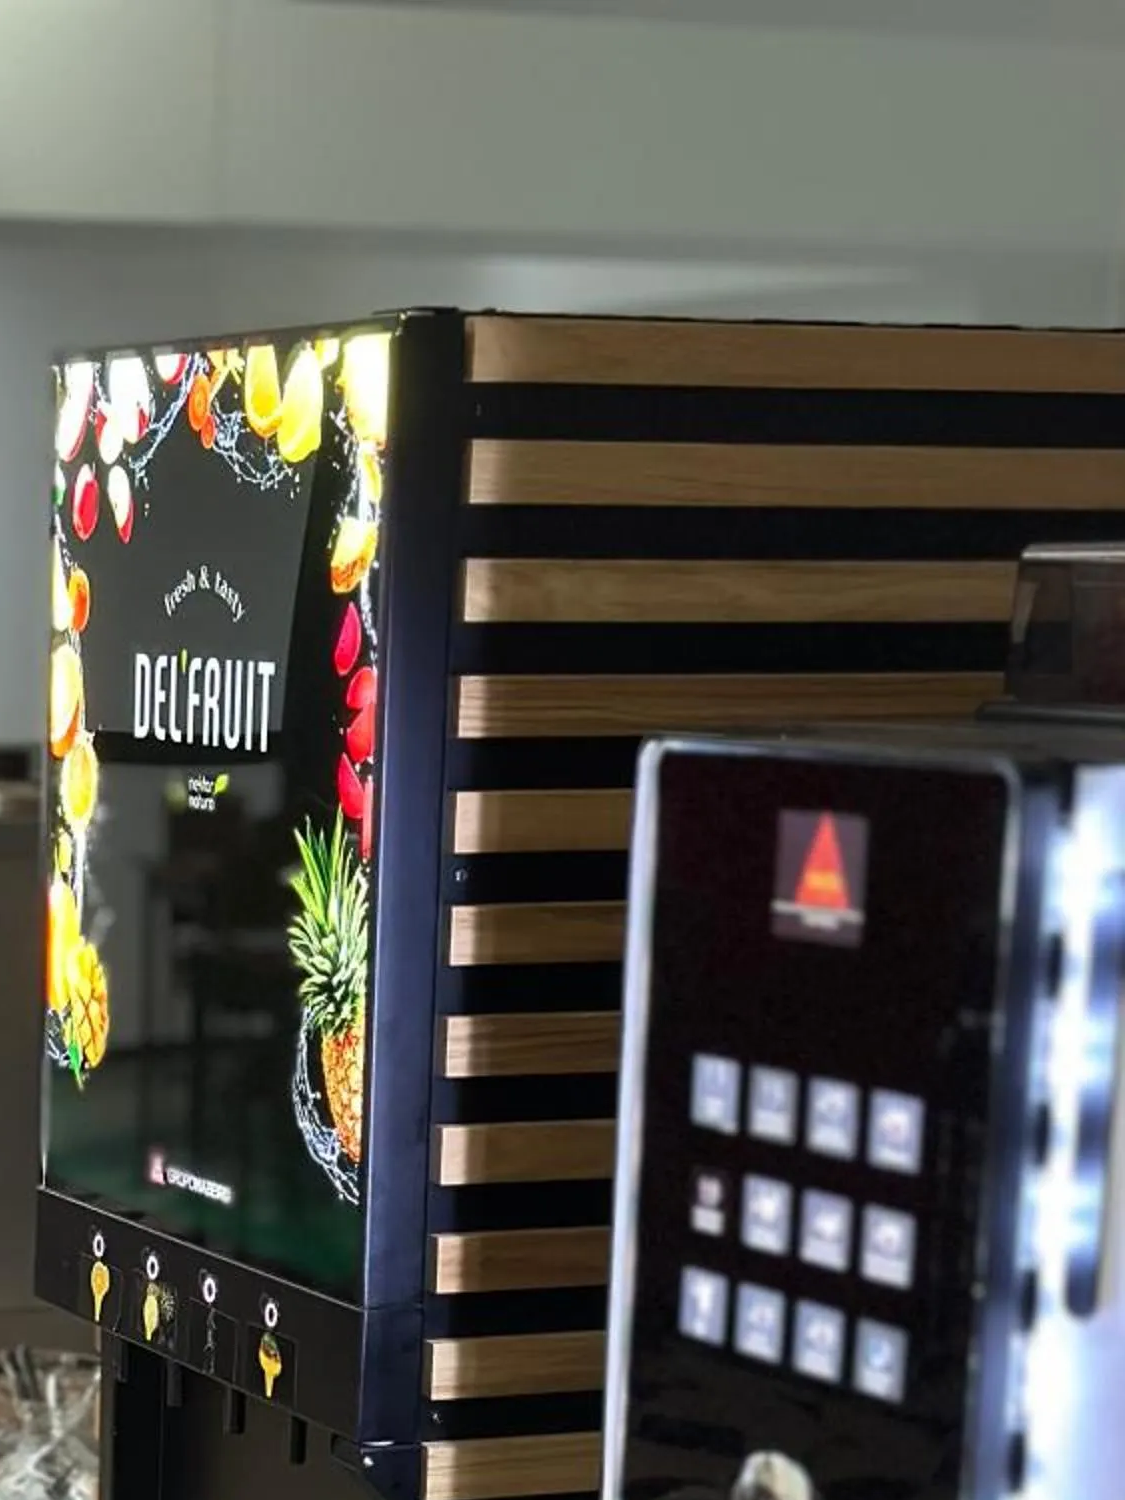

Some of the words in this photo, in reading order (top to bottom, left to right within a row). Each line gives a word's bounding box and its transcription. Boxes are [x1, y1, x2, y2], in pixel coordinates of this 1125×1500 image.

[164, 569, 196, 617] fresh
[198, 565, 211, 590] &
[214, 571, 246, 623] tasty
